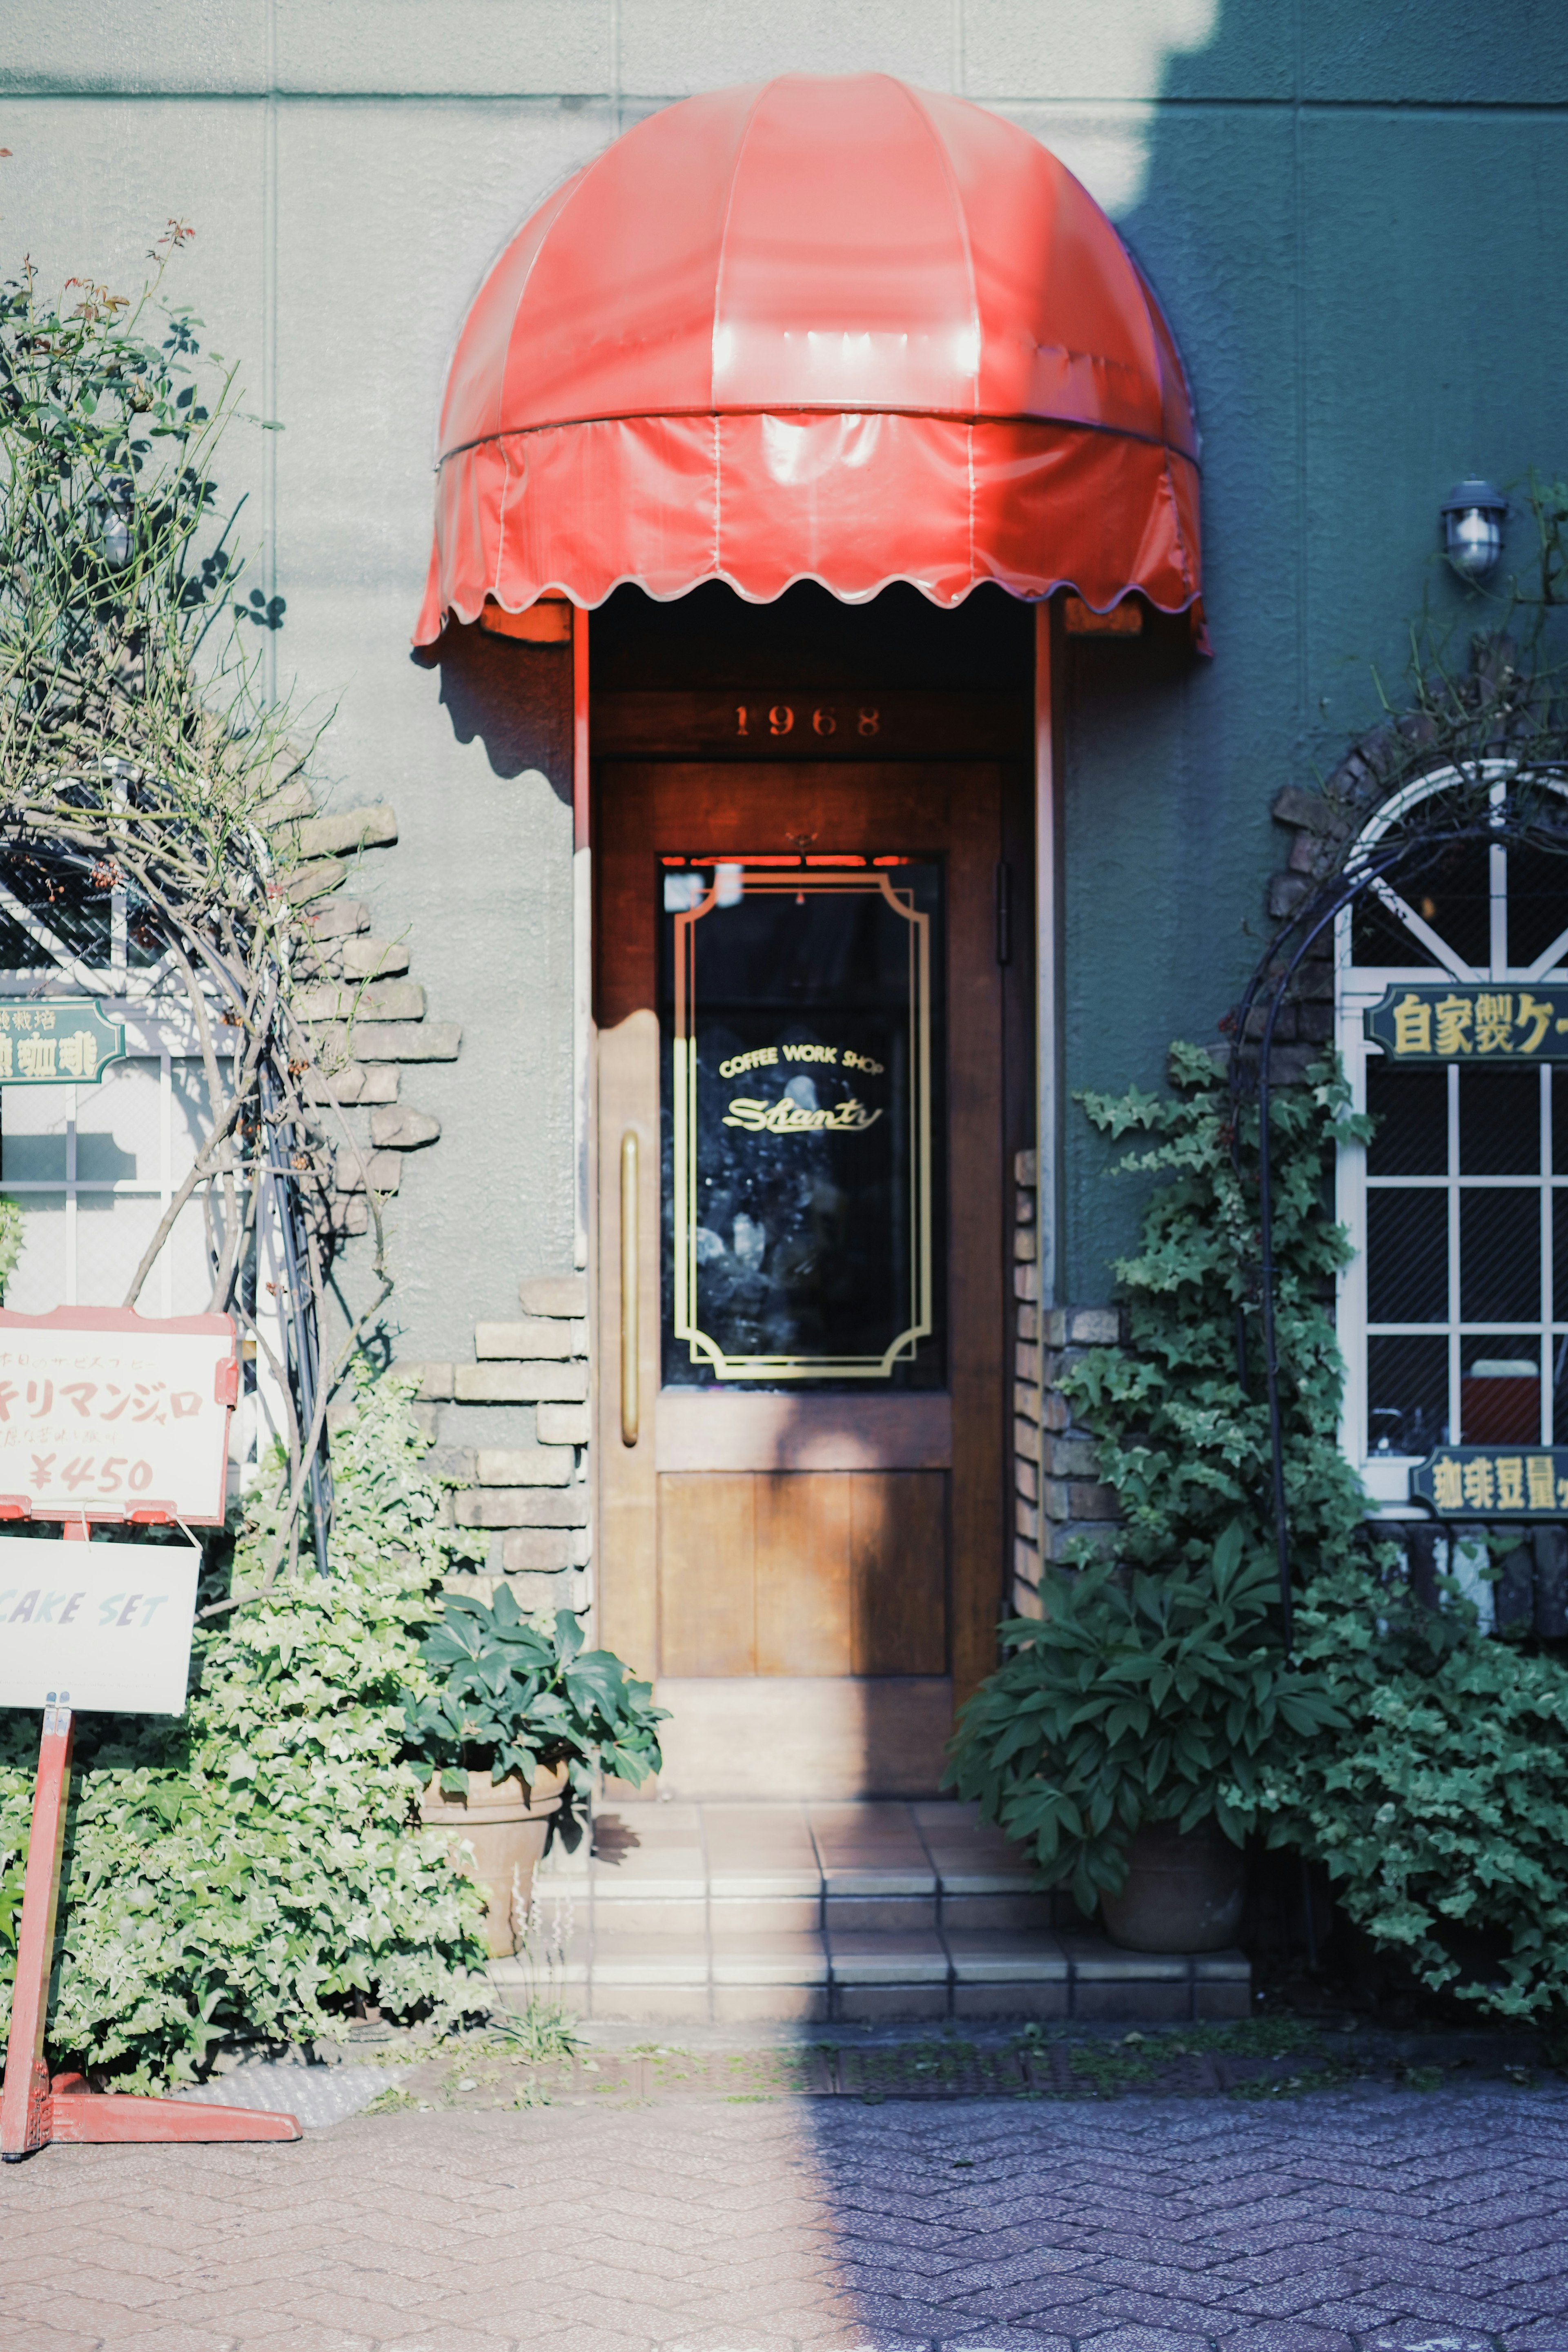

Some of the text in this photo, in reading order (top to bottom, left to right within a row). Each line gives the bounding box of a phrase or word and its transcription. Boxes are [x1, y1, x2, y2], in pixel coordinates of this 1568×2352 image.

[736, 706, 879, 735] 1968
[719, 1044, 884, 1078] COFFEE WORK SHOP
[722, 1097, 883, 1134] Shanty
[30, 1453, 153, 1492] ¥450
[98, 1593, 169, 1627] SET
